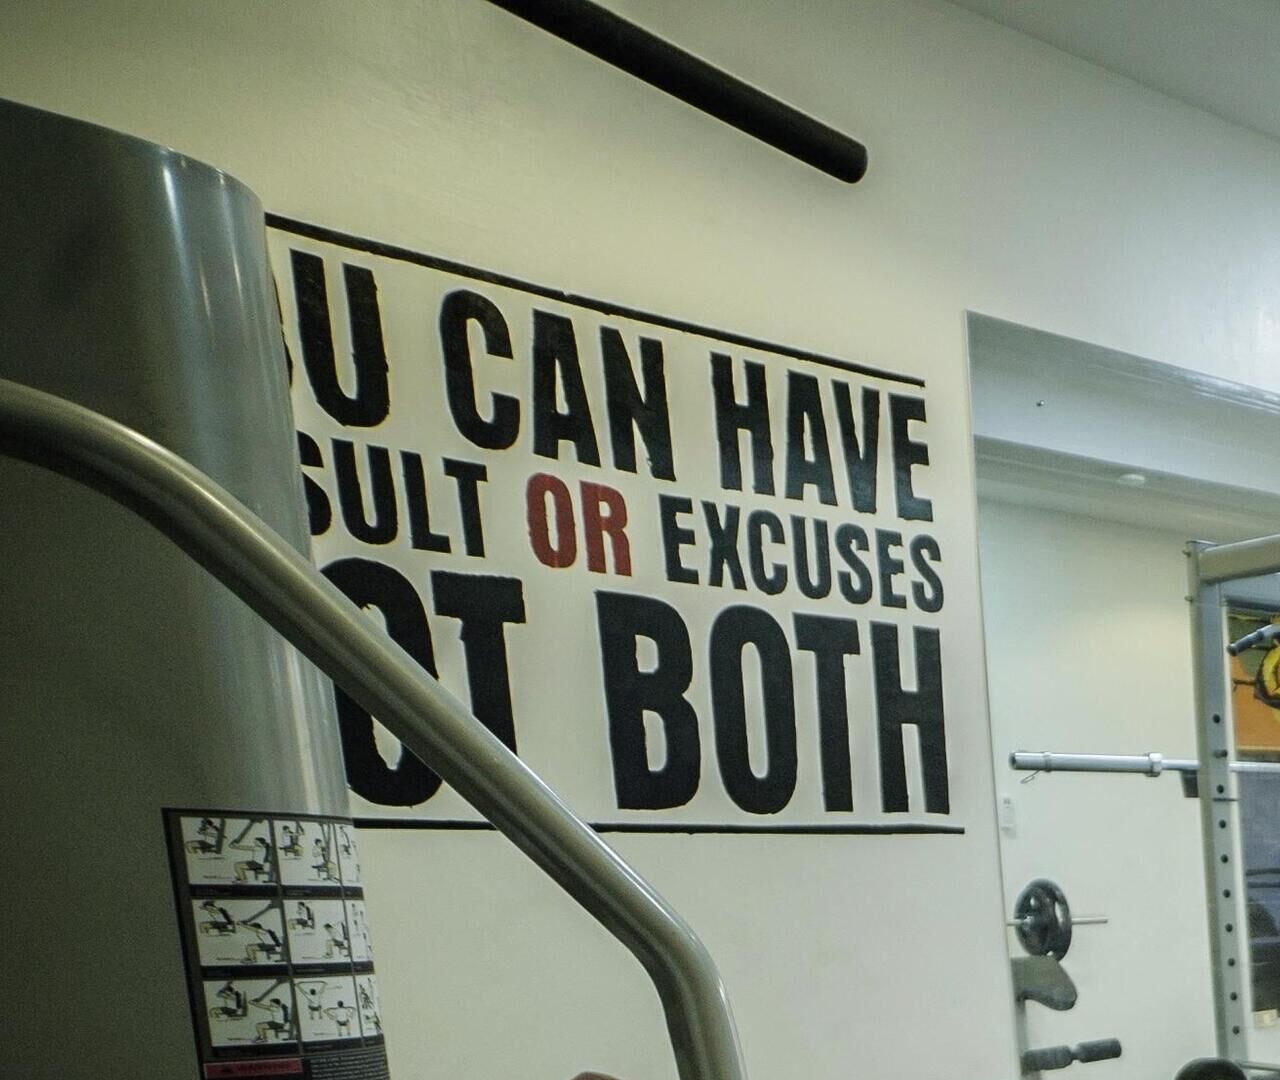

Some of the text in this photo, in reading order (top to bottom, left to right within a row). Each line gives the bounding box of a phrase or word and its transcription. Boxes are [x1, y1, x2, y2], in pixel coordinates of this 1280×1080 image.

[440, 288, 677, 483] CAN
[709, 351, 934, 523] HAVE
[525, 472, 632, 578] OR
[660, 496, 945, 613] EXCUSES
[594, 588, 950, 815] BOTH
